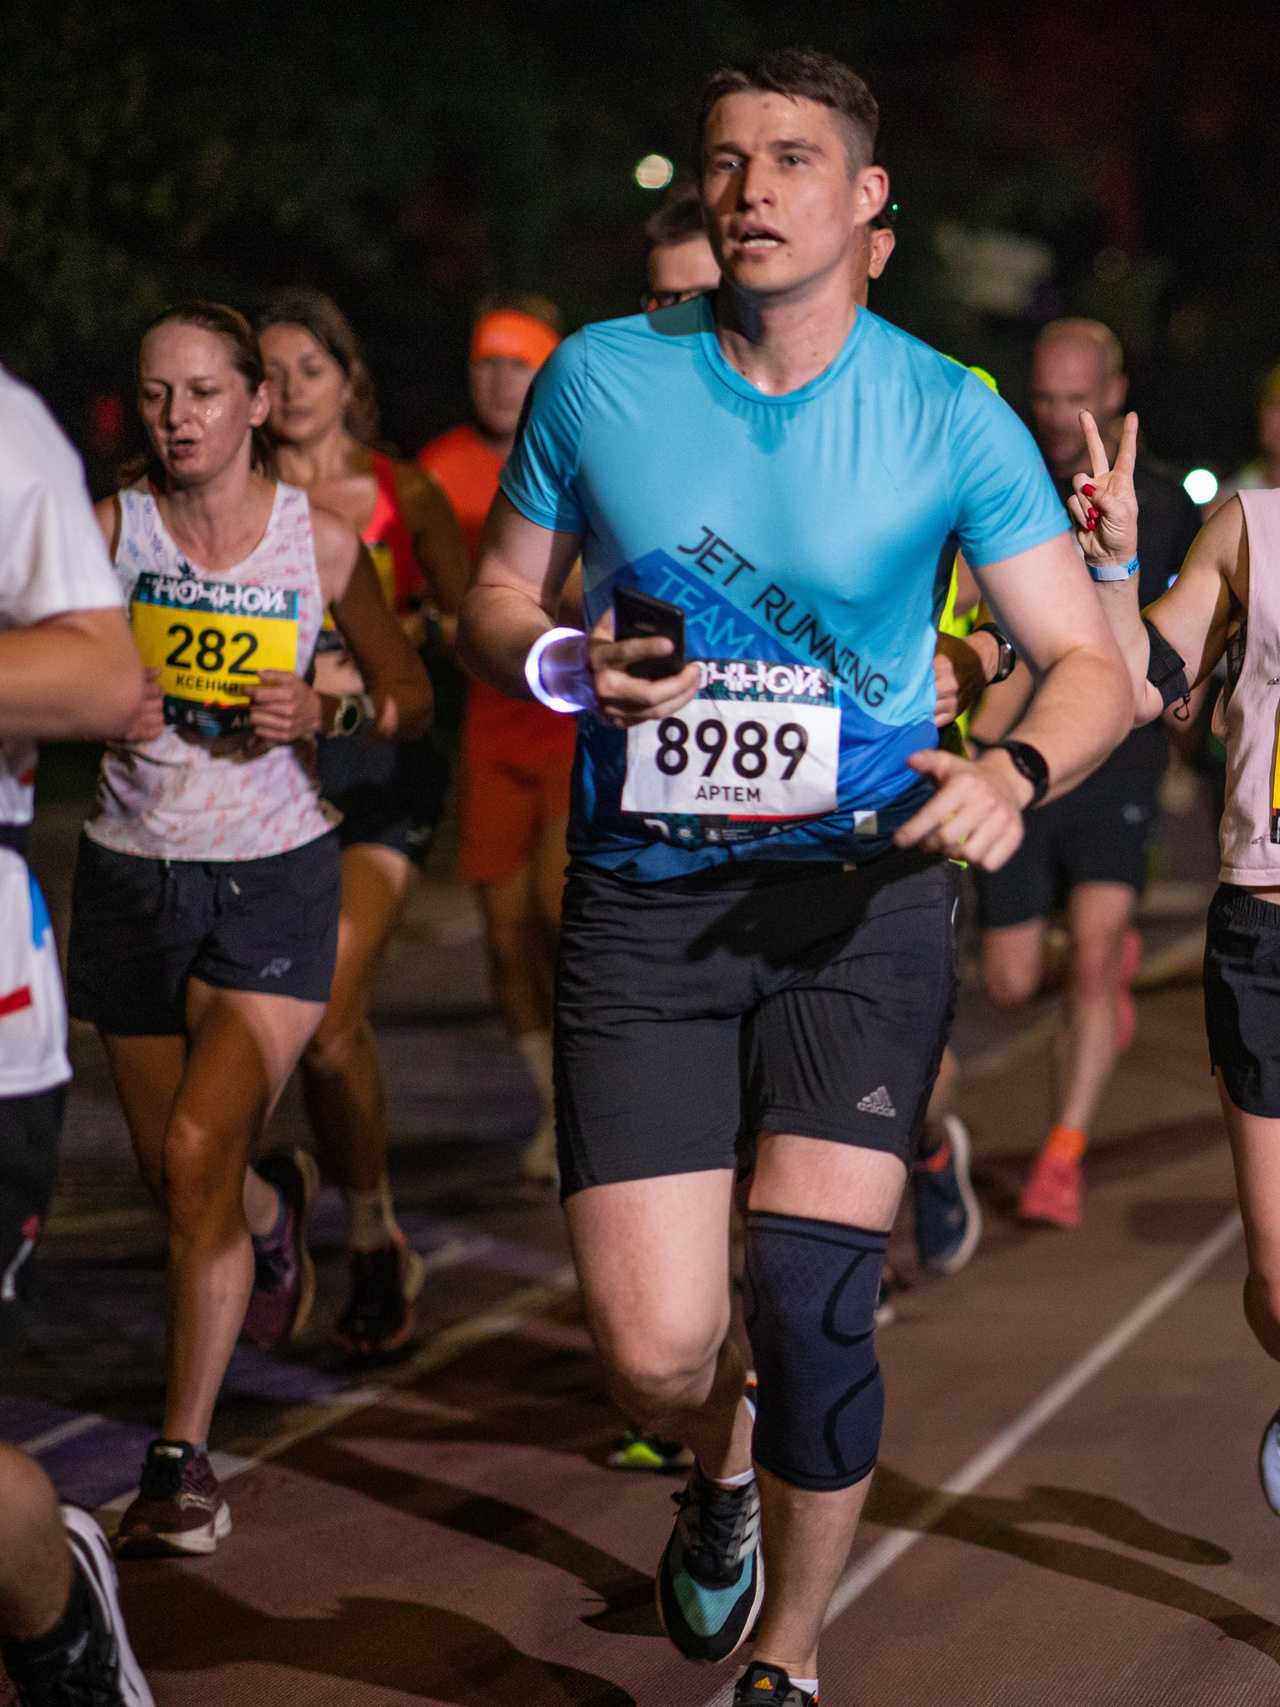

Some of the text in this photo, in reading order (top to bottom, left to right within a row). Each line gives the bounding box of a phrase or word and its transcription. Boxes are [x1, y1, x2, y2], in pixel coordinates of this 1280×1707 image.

[146, 576, 288, 613] НОЧНОЙ
[677, 525, 889, 708] JET RUNNING
[165, 623, 259, 676] 282
[655, 717, 809, 781] 8989
[695, 785, 761, 803] АРТЕМ
